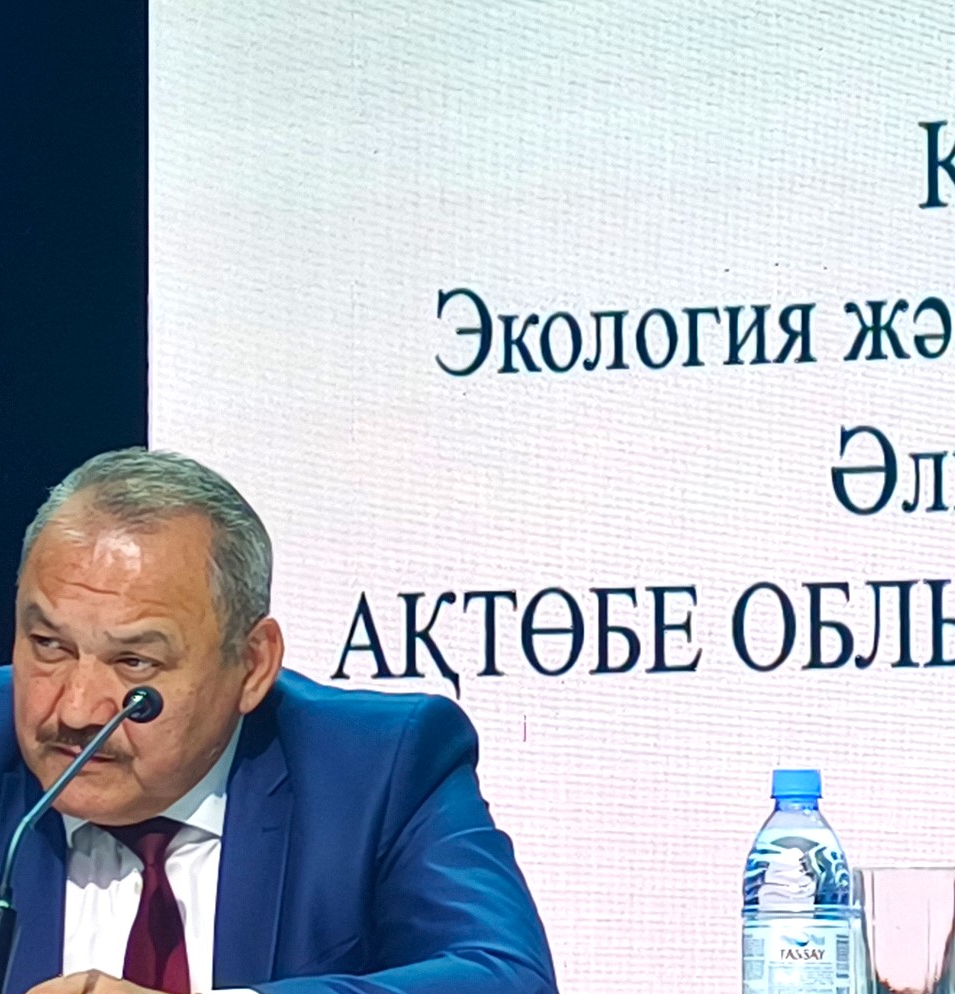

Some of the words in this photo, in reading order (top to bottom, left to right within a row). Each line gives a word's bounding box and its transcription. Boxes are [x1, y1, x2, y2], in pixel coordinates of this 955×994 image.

[435, 287, 817, 377] Экология
[843, 296, 952, 361] жә
[831, 425, 955, 516] Әл
[330, 584, 703, 700] АҚТӨБЕ
[780, 948, 825, 961] TASSAY
